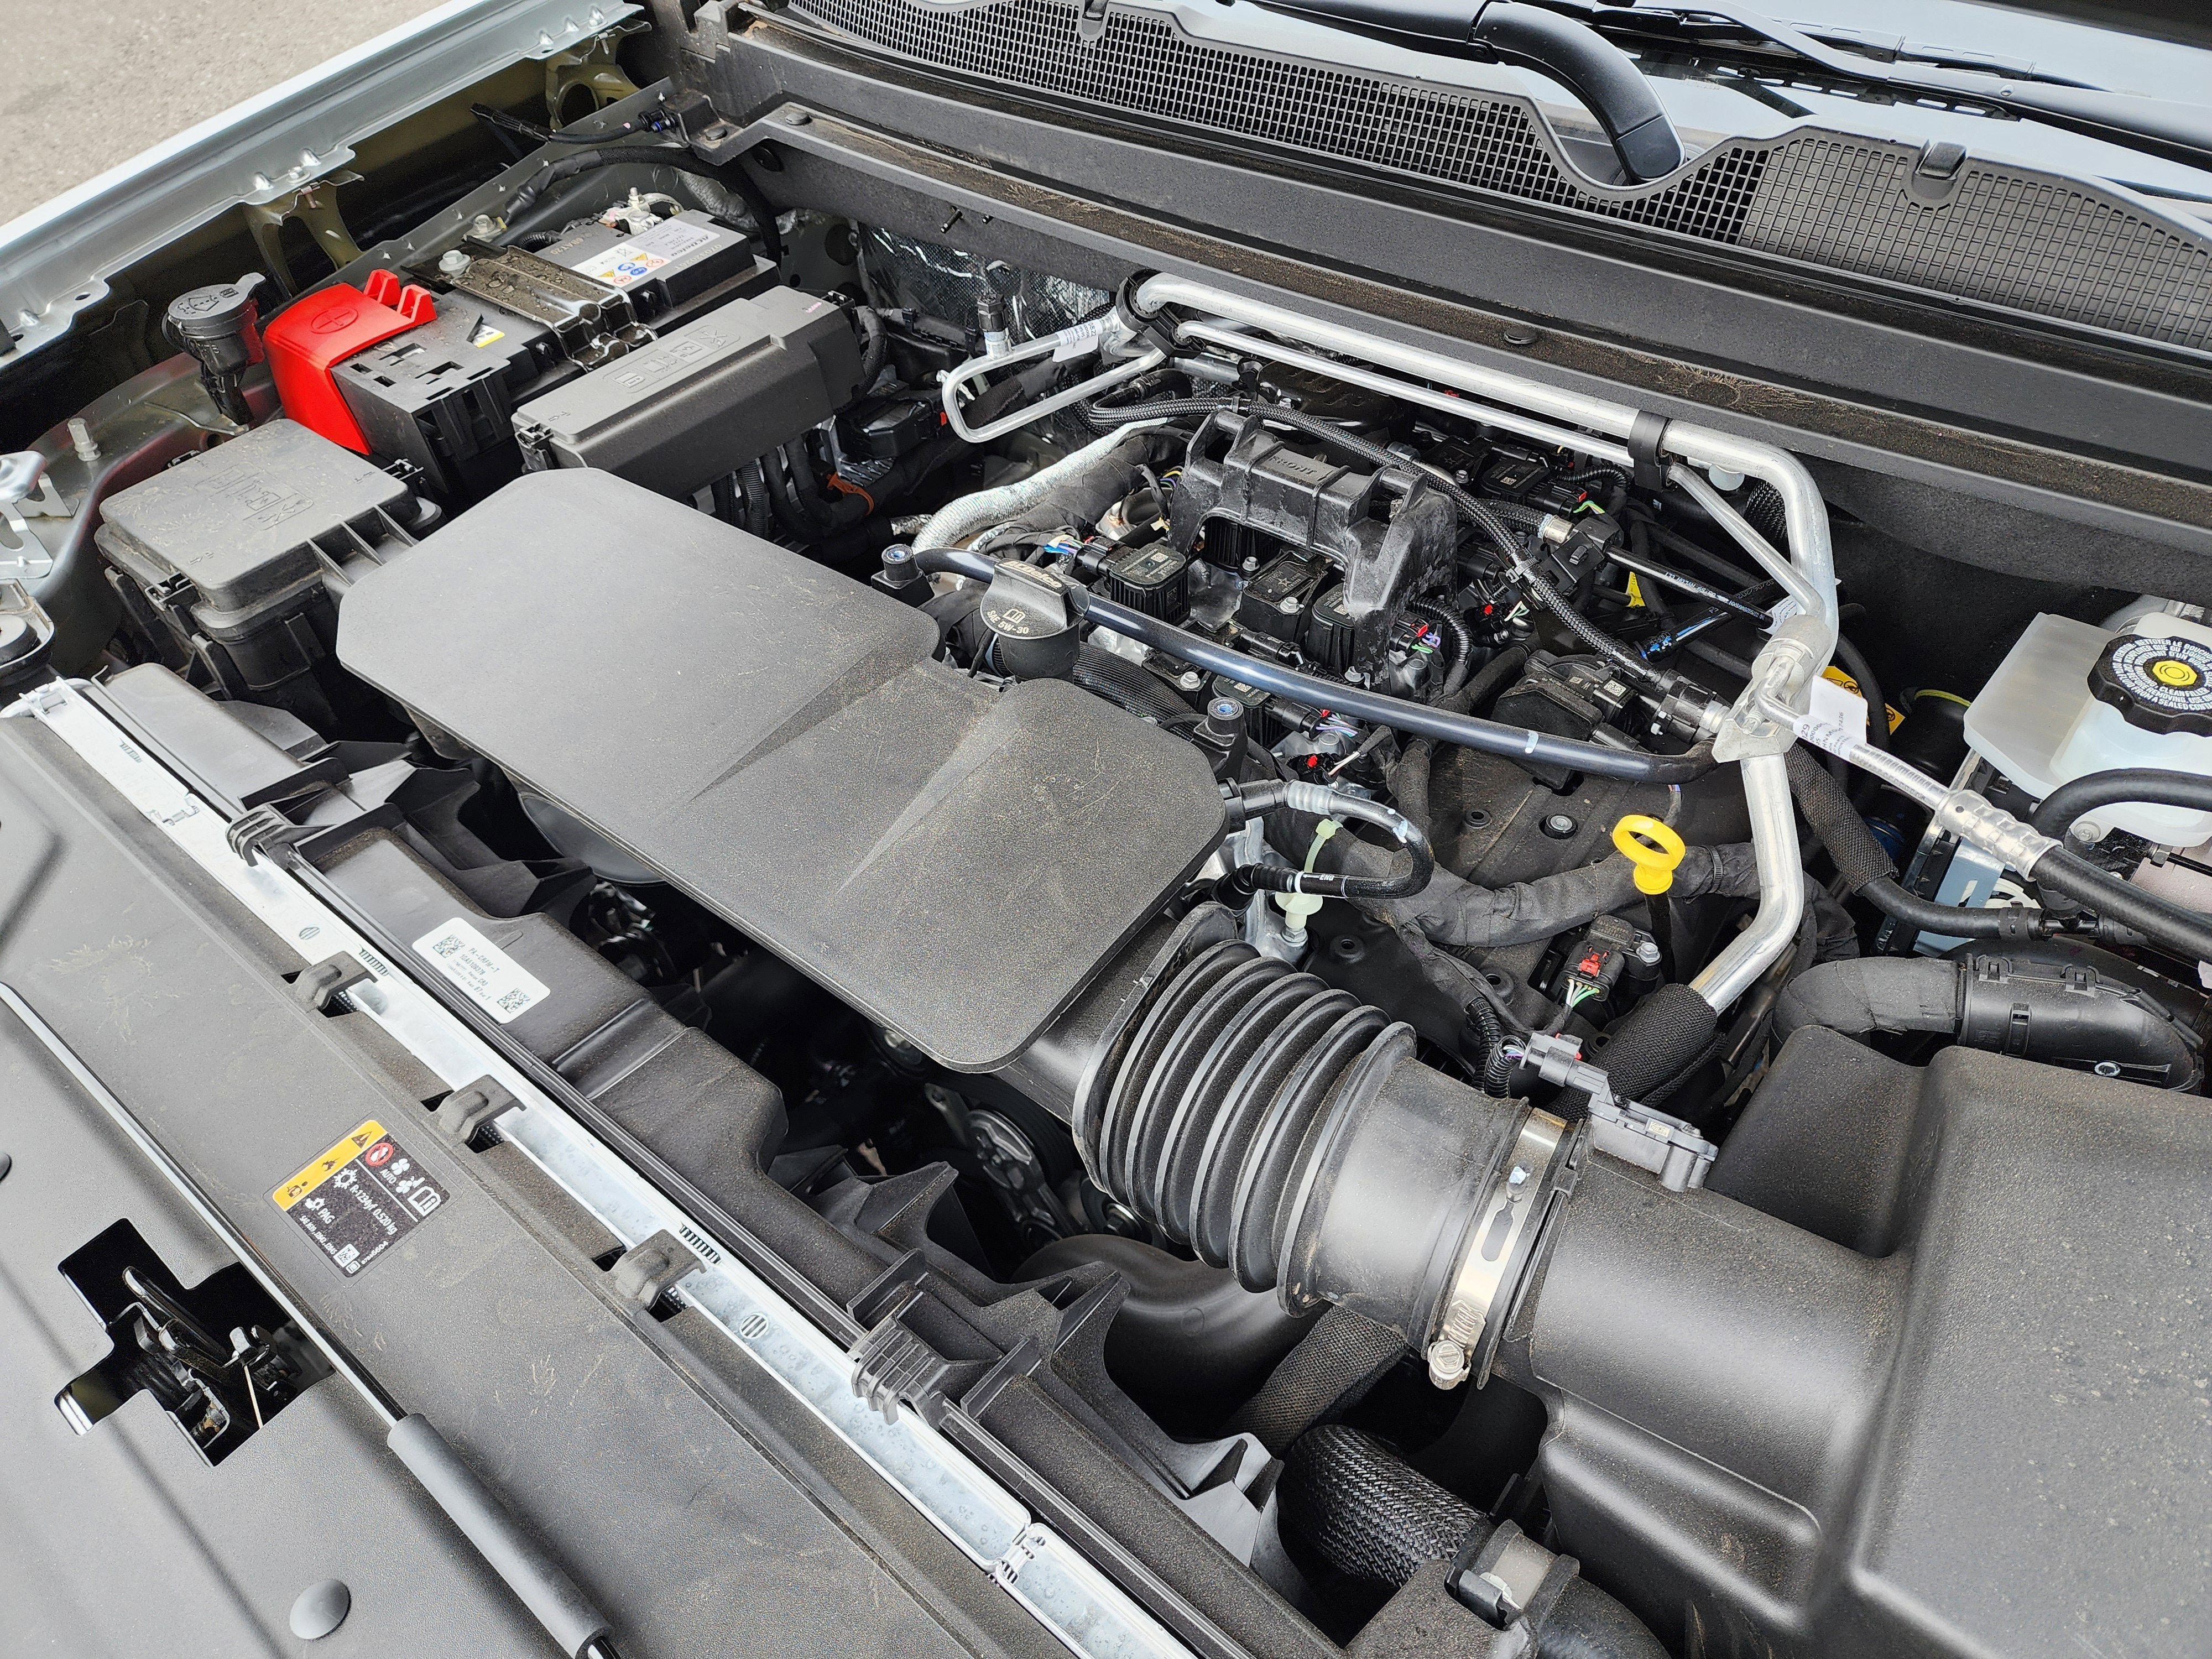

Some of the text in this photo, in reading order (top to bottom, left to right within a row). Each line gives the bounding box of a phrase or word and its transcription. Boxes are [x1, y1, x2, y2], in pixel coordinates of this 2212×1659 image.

[1269, 455, 1318, 474] FRONT
[999, 560, 1062, 588] ACDelco
[1676, 576, 1695, 589] NYLON
[987, 610, 1030, 635] SAE 5W-30
[2112, 643, 2137, 662] ATTENTION:
[2184, 643, 2212, 660] BOUCHO
[2134, 650, 2167, 666] PROVENANT
[2168, 651, 2188, 660] D'UN
[2188, 657, 2210, 671] BIDON
[2182, 648, 2210, 664] LIQUIDE
[2123, 664, 2135, 673] CAP
[2126, 672, 2150, 690] BEFORE
[2117, 674, 2136, 688] FLUID
[2131, 686, 2153, 701] FROM
[2158, 697, 2188, 709] SEALED
[2146, 687, 2189, 704] REMOVING.
[2158, 686, 2185, 697] CLEAN
[2184, 687, 2210, 697] FILLER
[380, 1168, 397, 1184] AUTO
[317, 1208, 335, 1224] PAG
[349, 1184, 398, 1235] R-1234yf 0.520 kg
[299, 1215, 310, 1225] SAE
